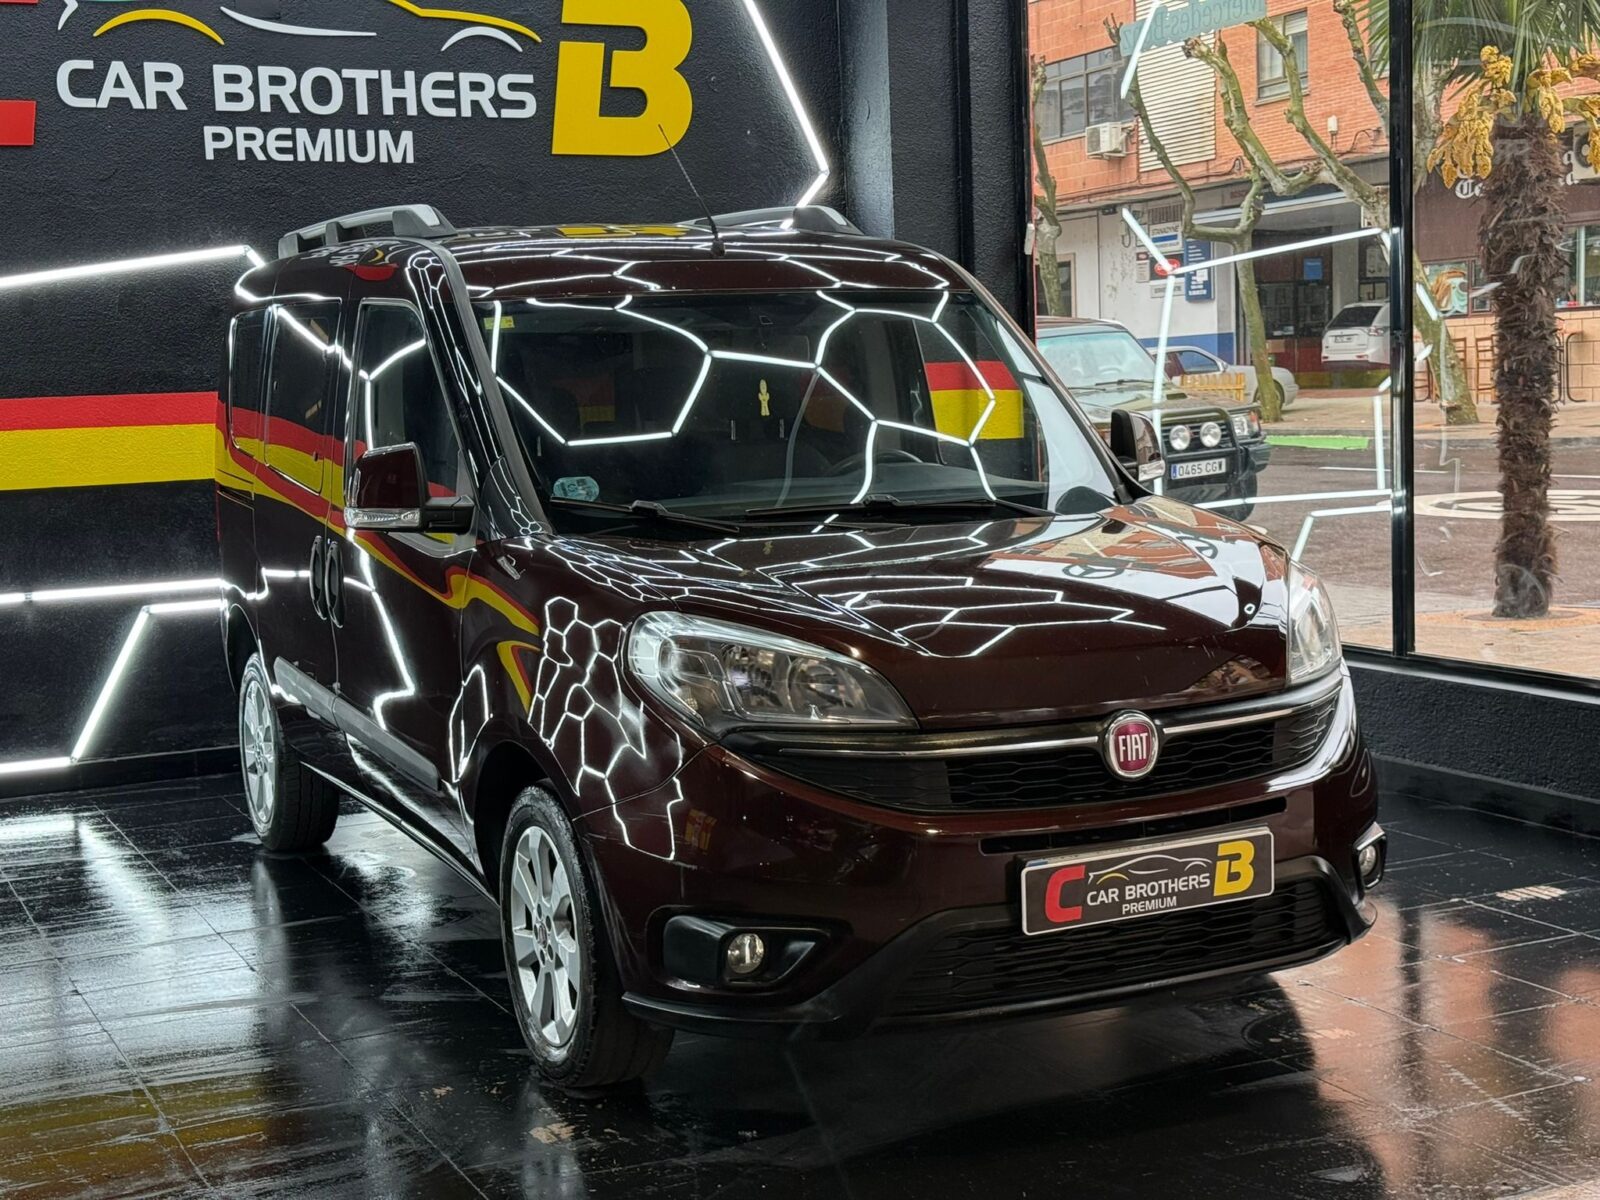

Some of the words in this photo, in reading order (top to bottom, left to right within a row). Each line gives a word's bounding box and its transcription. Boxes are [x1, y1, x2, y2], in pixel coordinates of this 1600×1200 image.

[56, 59, 188, 111] CAR
[212, 63, 538, 120] BROTHERS
[202, 125, 416, 165] PREMIUM
[1178, 463, 1203, 477] 0465
[1118, 732, 1149, 762] FIAT
[1045, 865, 1086, 923] C
[1086, 888, 1119, 906] CAR
[1125, 873, 1211, 901] BROTHERS
[1122, 896, 1177, 915] PREMIUM
